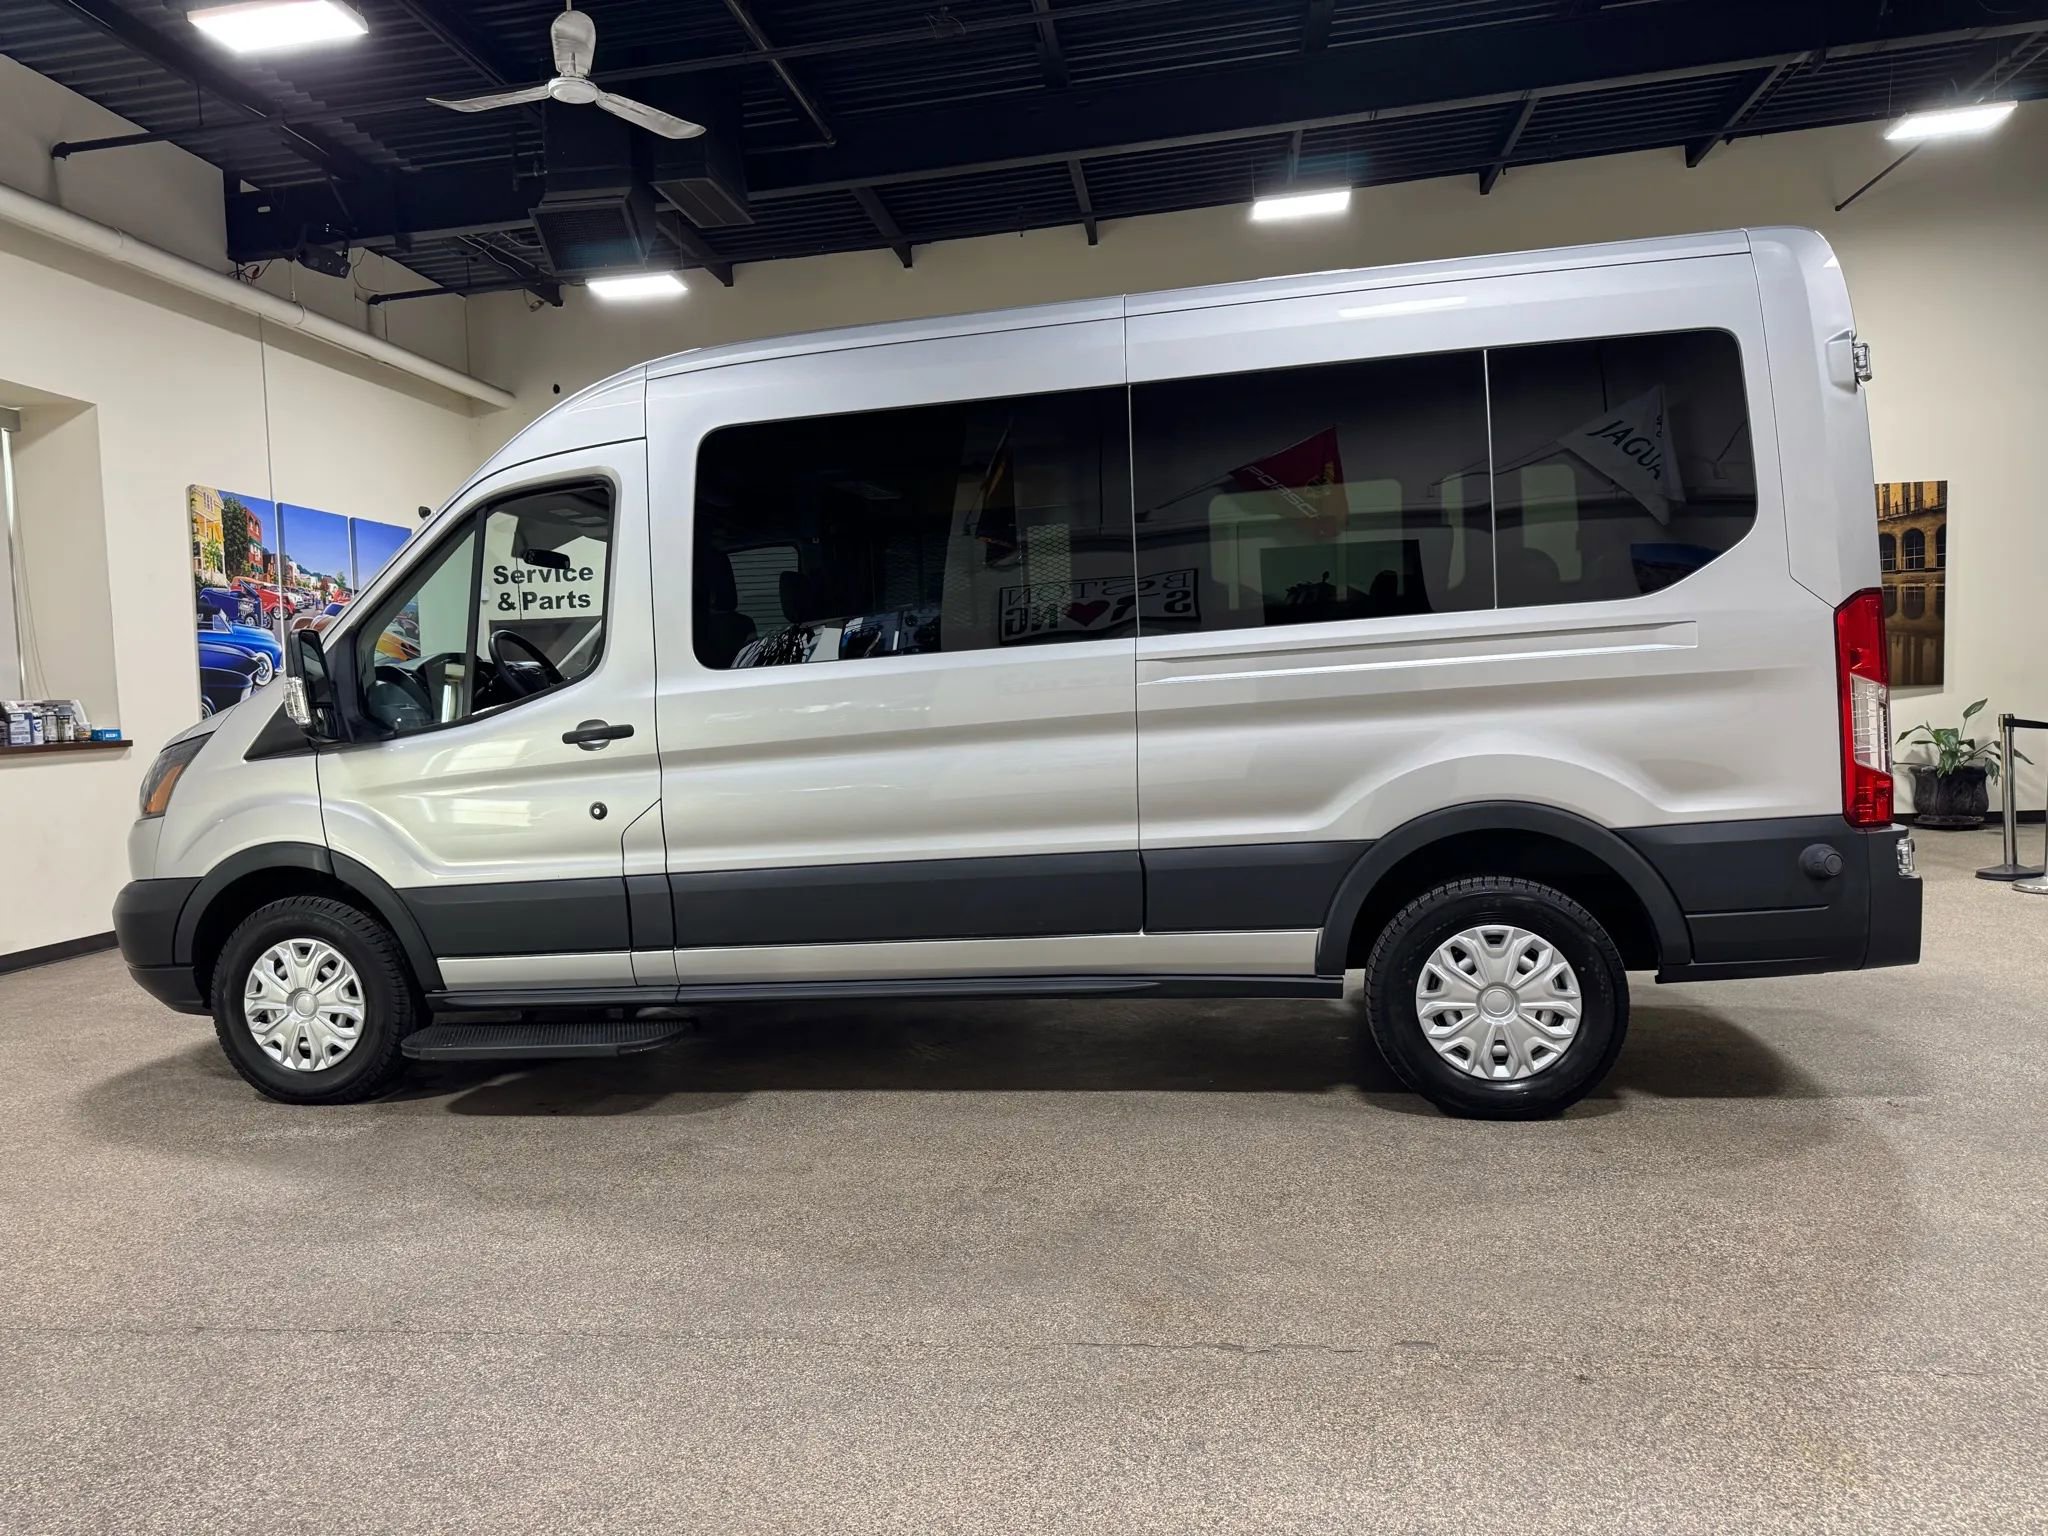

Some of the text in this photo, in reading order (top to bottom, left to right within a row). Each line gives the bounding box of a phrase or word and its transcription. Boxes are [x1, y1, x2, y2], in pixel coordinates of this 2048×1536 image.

[493, 565, 594, 584] Service
[497, 590, 591, 611] & Parts
